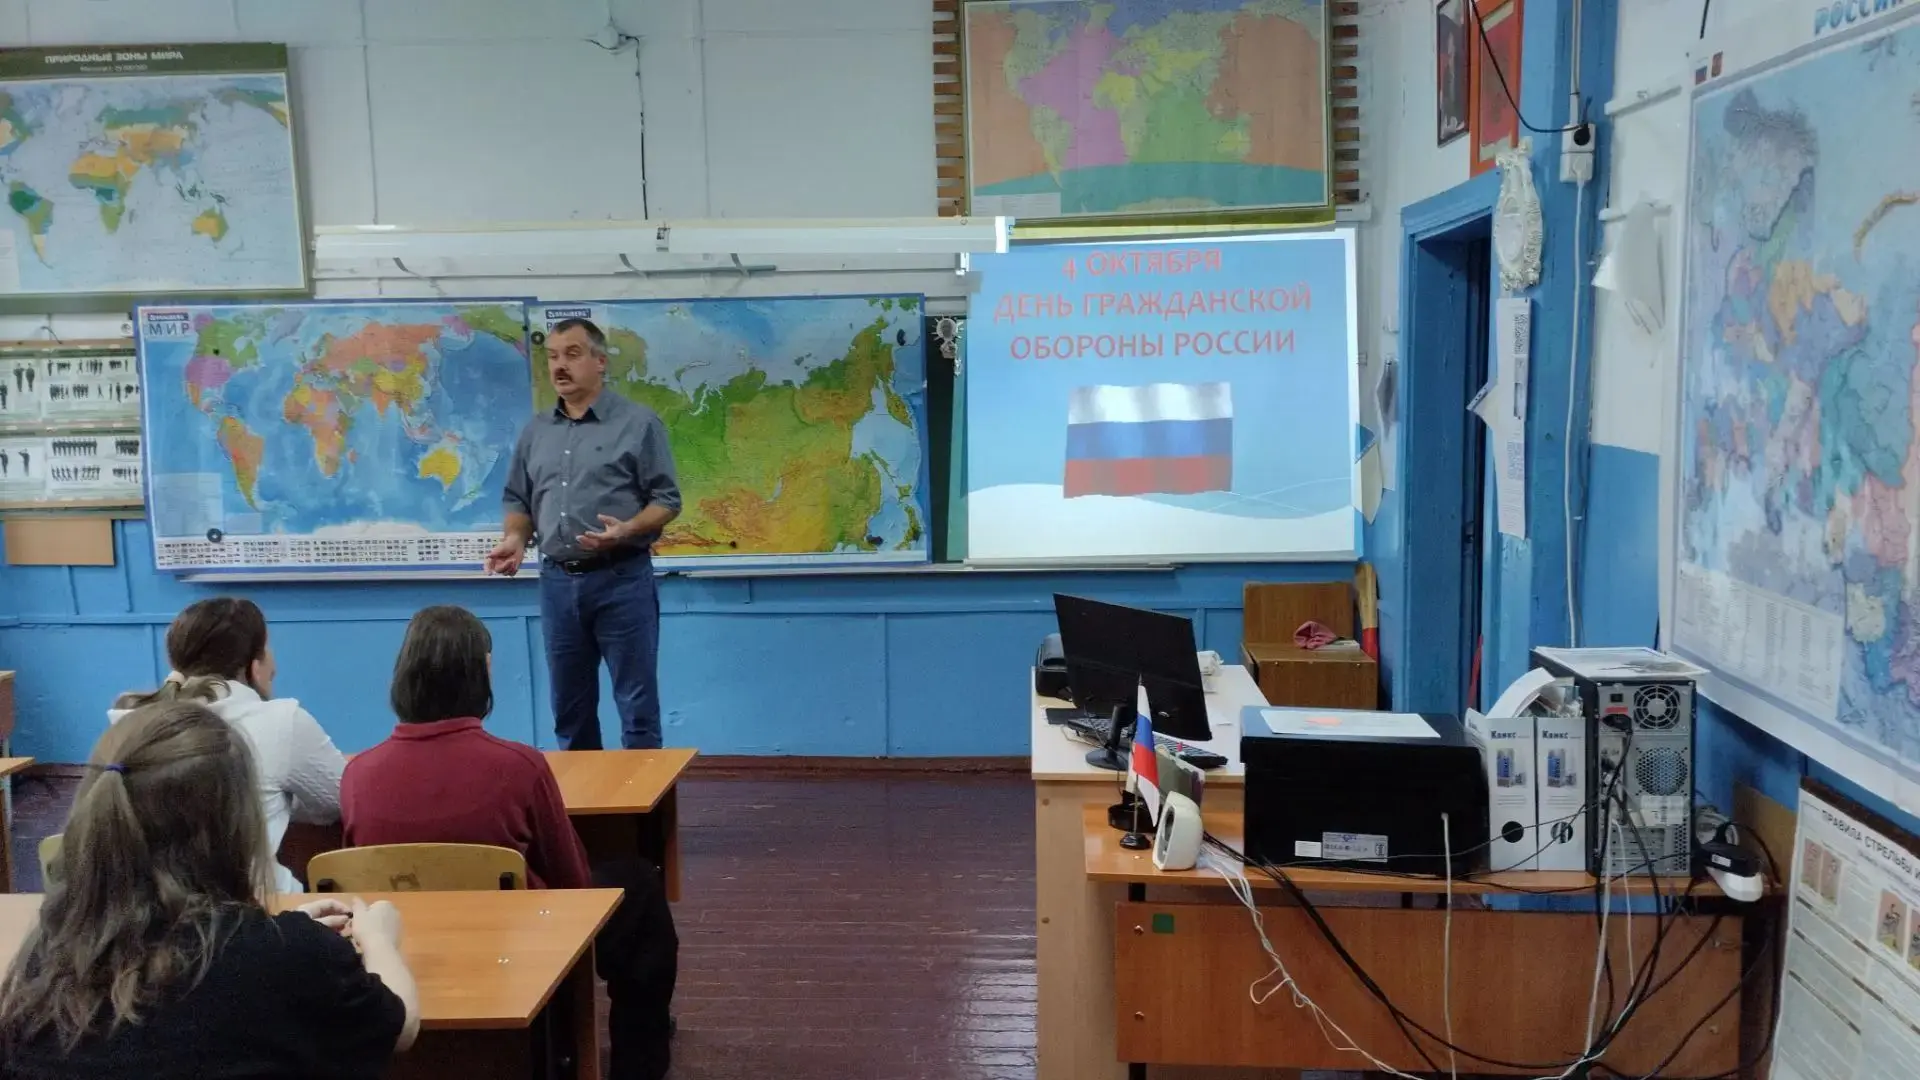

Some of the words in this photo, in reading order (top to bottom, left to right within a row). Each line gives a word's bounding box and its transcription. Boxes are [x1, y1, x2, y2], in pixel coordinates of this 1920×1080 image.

[1814, 0, 1903, 36] РОСС
[44, 53, 112, 64] ПРИРОДНЫЕ
[116, 52, 147, 61] ЗОНЫ
[151, 51, 184, 60] МИРА
[1062, 258, 1077, 282] 4
[1086, 249, 1222, 276] ОКТЯБРЯ
[994, 294, 1074, 323] ДЕНЬ
[1083, 282, 1312, 320] ГРАЖДАНСКОЙ
[149, 322, 190, 336] МИР
[1010, 334, 1163, 360] ОБОРОНЫ
[1174, 329, 1296, 357] РОССИИ
[1822, 810, 1862, 841] ПРАВИЛА
[1864, 836, 1912, 875] СТРЕЛЬБЫ
